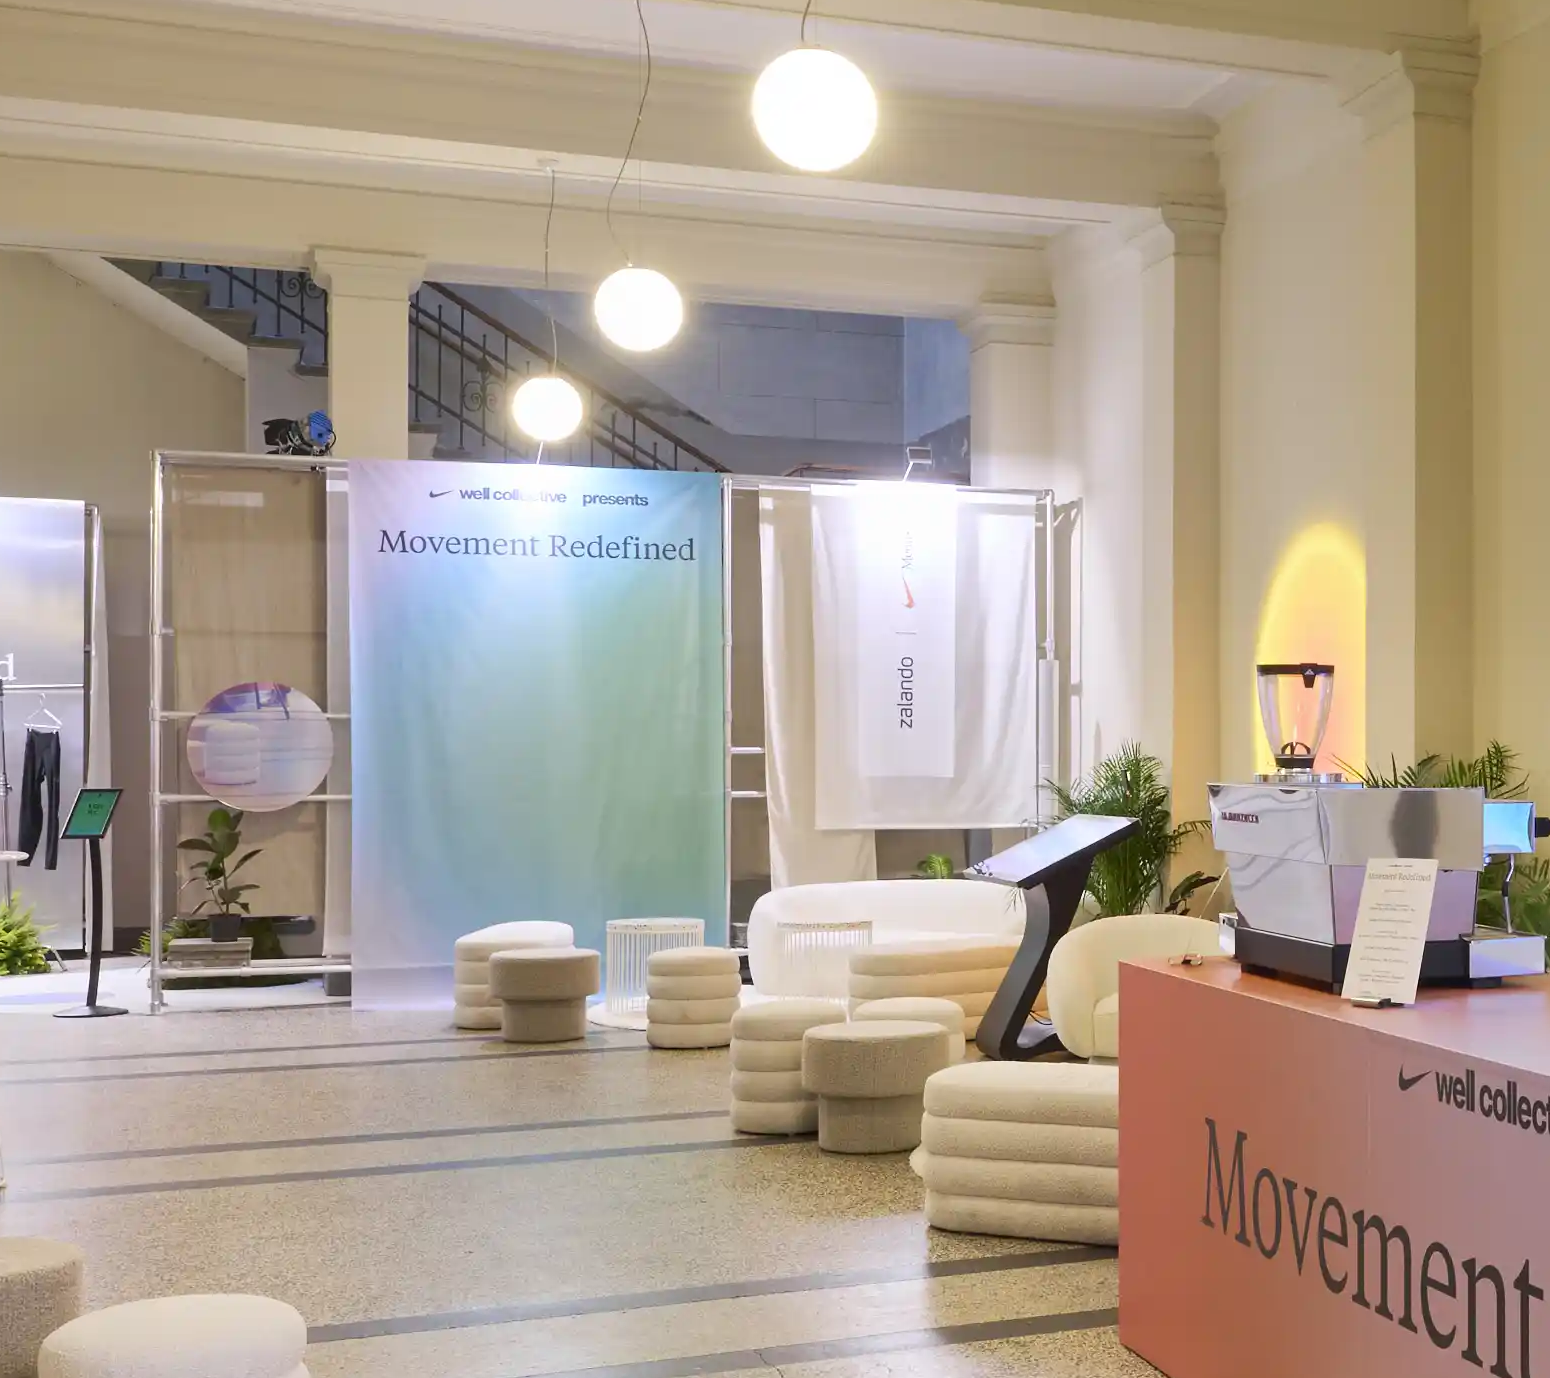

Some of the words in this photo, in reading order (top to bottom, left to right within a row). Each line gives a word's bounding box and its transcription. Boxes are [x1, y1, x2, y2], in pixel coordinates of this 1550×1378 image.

[459, 487, 490, 500] well
[493, 488, 567, 504] colltive
[582, 493, 649, 508] presents
[377, 529, 541, 558] Movement
[548, 534, 697, 562] Redefined
[896, 655, 915, 729] zalando
[1434, 1068, 1476, 1116] well
